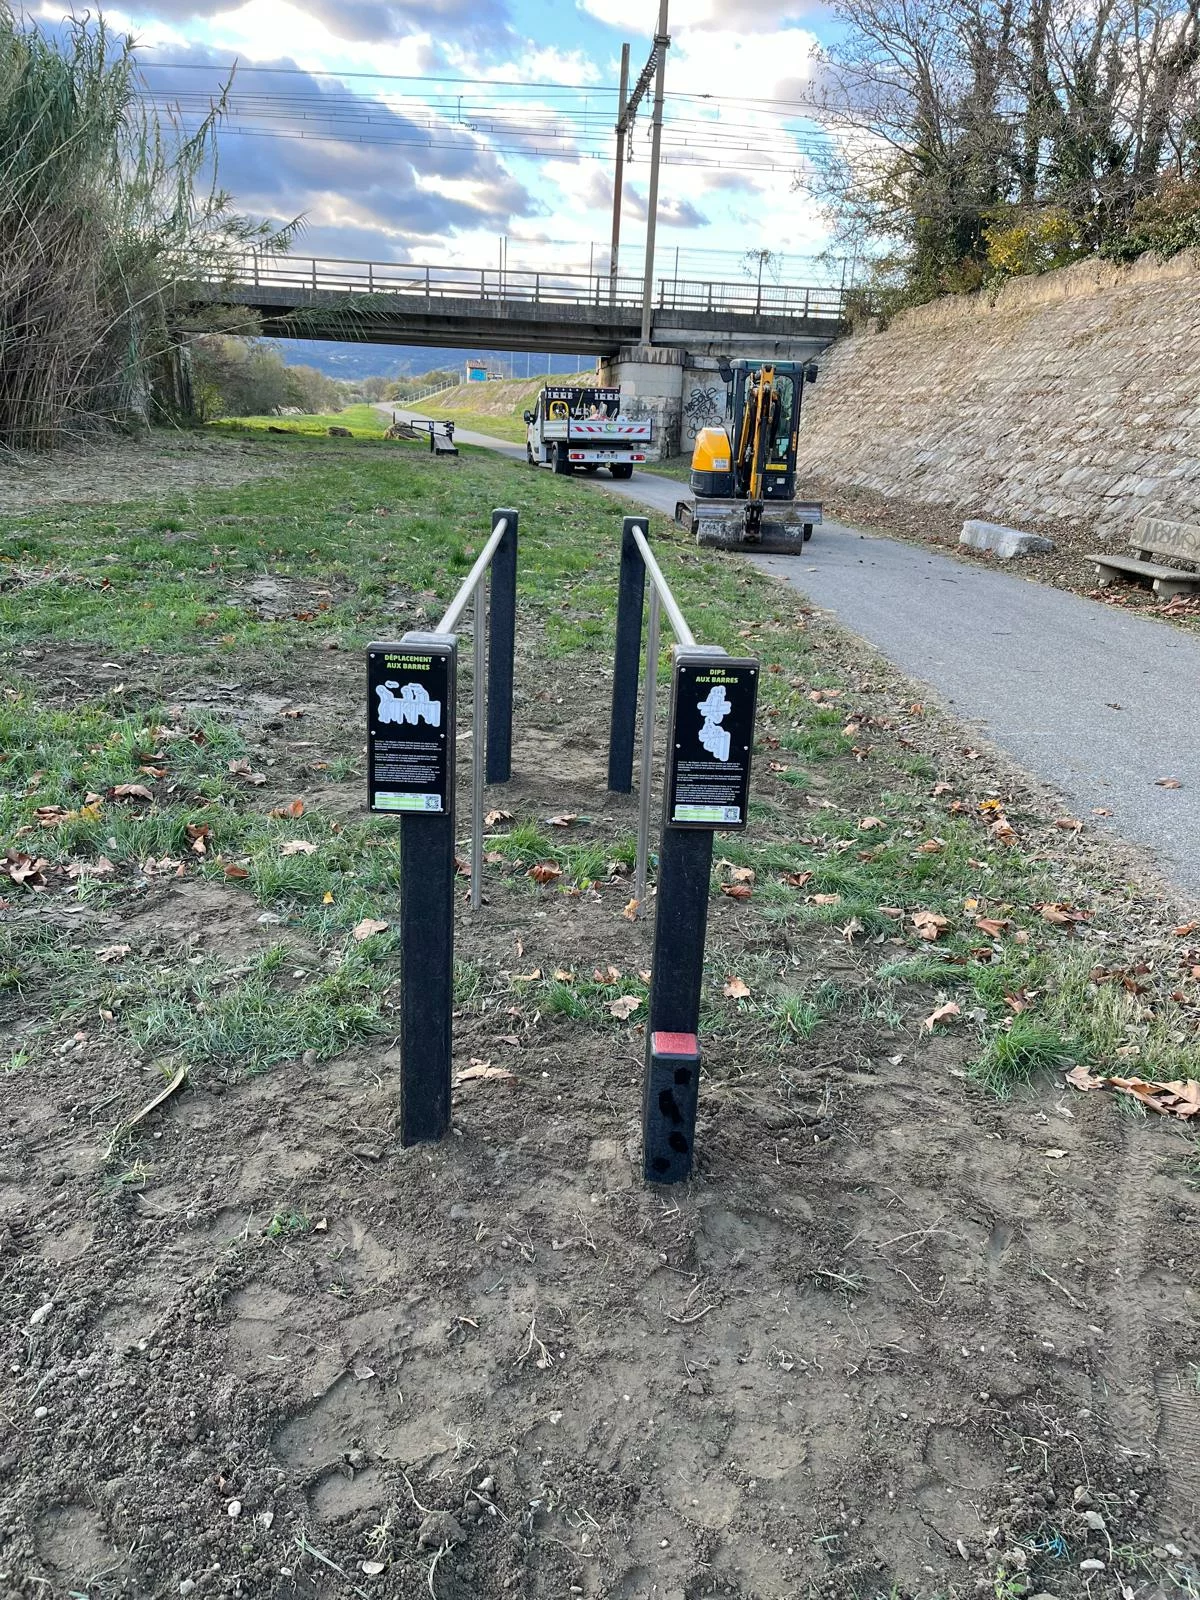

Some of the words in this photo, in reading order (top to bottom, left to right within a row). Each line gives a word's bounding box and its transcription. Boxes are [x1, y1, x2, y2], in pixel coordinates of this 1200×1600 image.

[384, 653, 433, 663] DÉPLACEMENT
[402, 663, 431, 671] BARRES
[711, 676, 739, 684] BARRES
